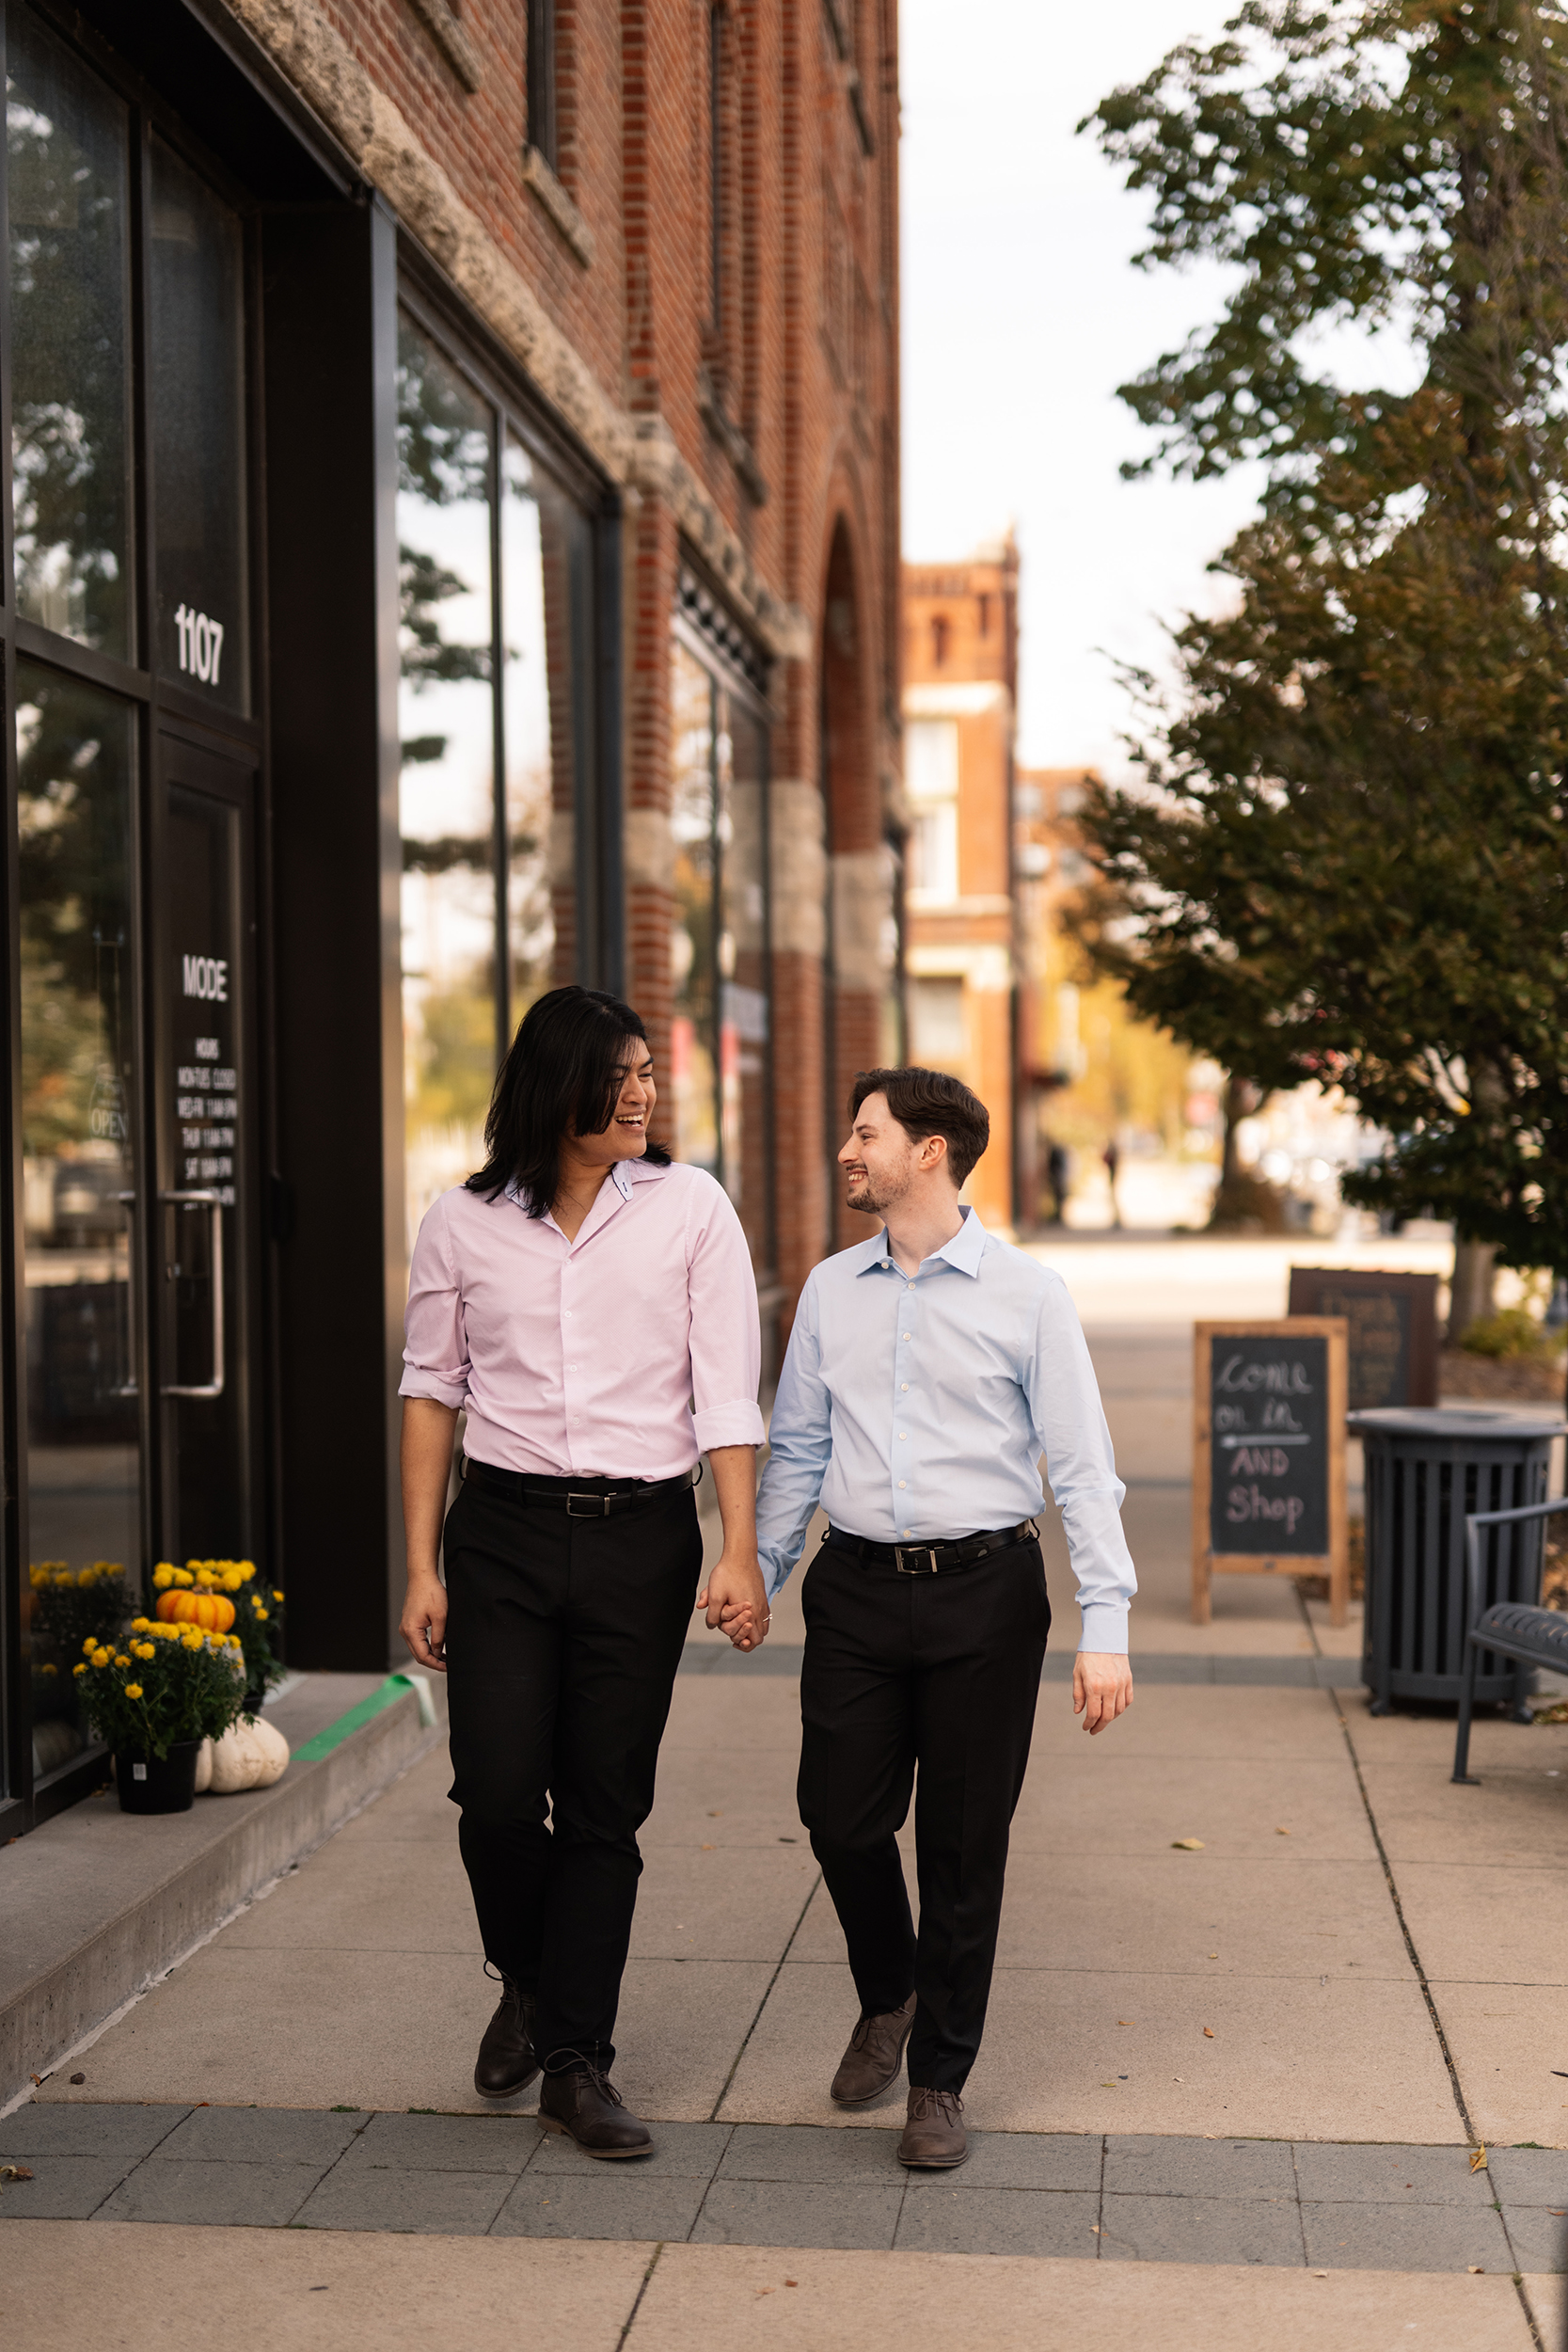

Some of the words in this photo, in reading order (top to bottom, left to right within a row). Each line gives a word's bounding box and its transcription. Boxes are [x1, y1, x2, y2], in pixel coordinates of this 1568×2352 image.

[174, 602, 224, 686] 1107
[183, 953, 228, 1002] MODE
[196, 1037, 220, 1059] HOURS
[91, 1107, 127, 1138] OPEN
[184, 1156, 198, 1180] SAT
[1229, 1447, 1290, 1476] AND
[1226, 1484, 1305, 1534] Shop
